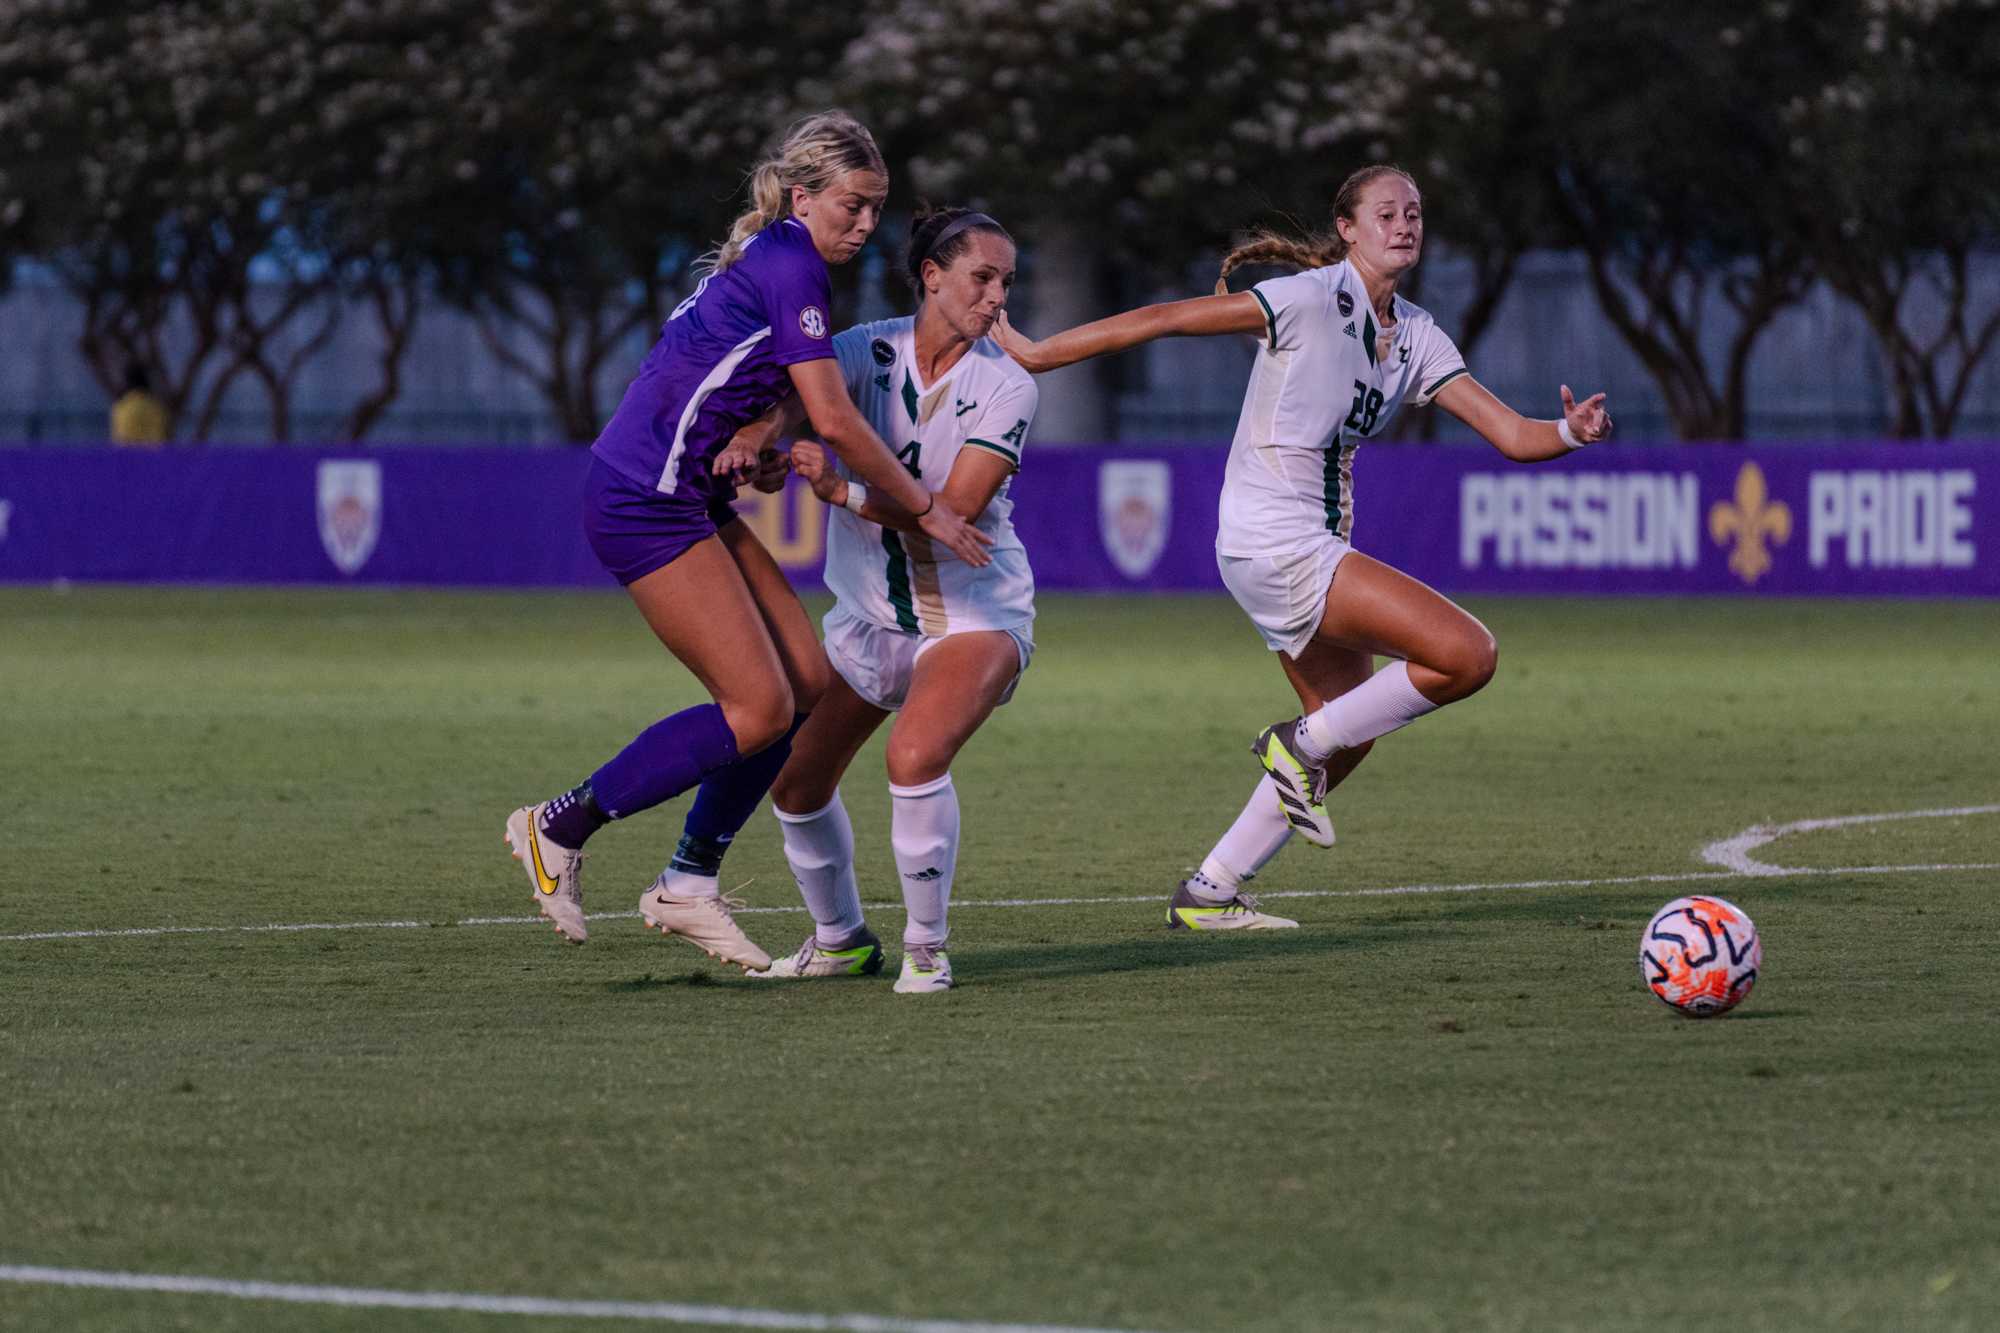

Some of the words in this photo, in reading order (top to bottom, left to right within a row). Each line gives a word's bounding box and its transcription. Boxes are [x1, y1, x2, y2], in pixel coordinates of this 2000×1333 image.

[1344, 379, 1384, 436] 28
[896, 440, 922, 480] 4
[1460, 472, 1698, 569] PASSION
[1809, 470, 1976, 568] PRIDE
